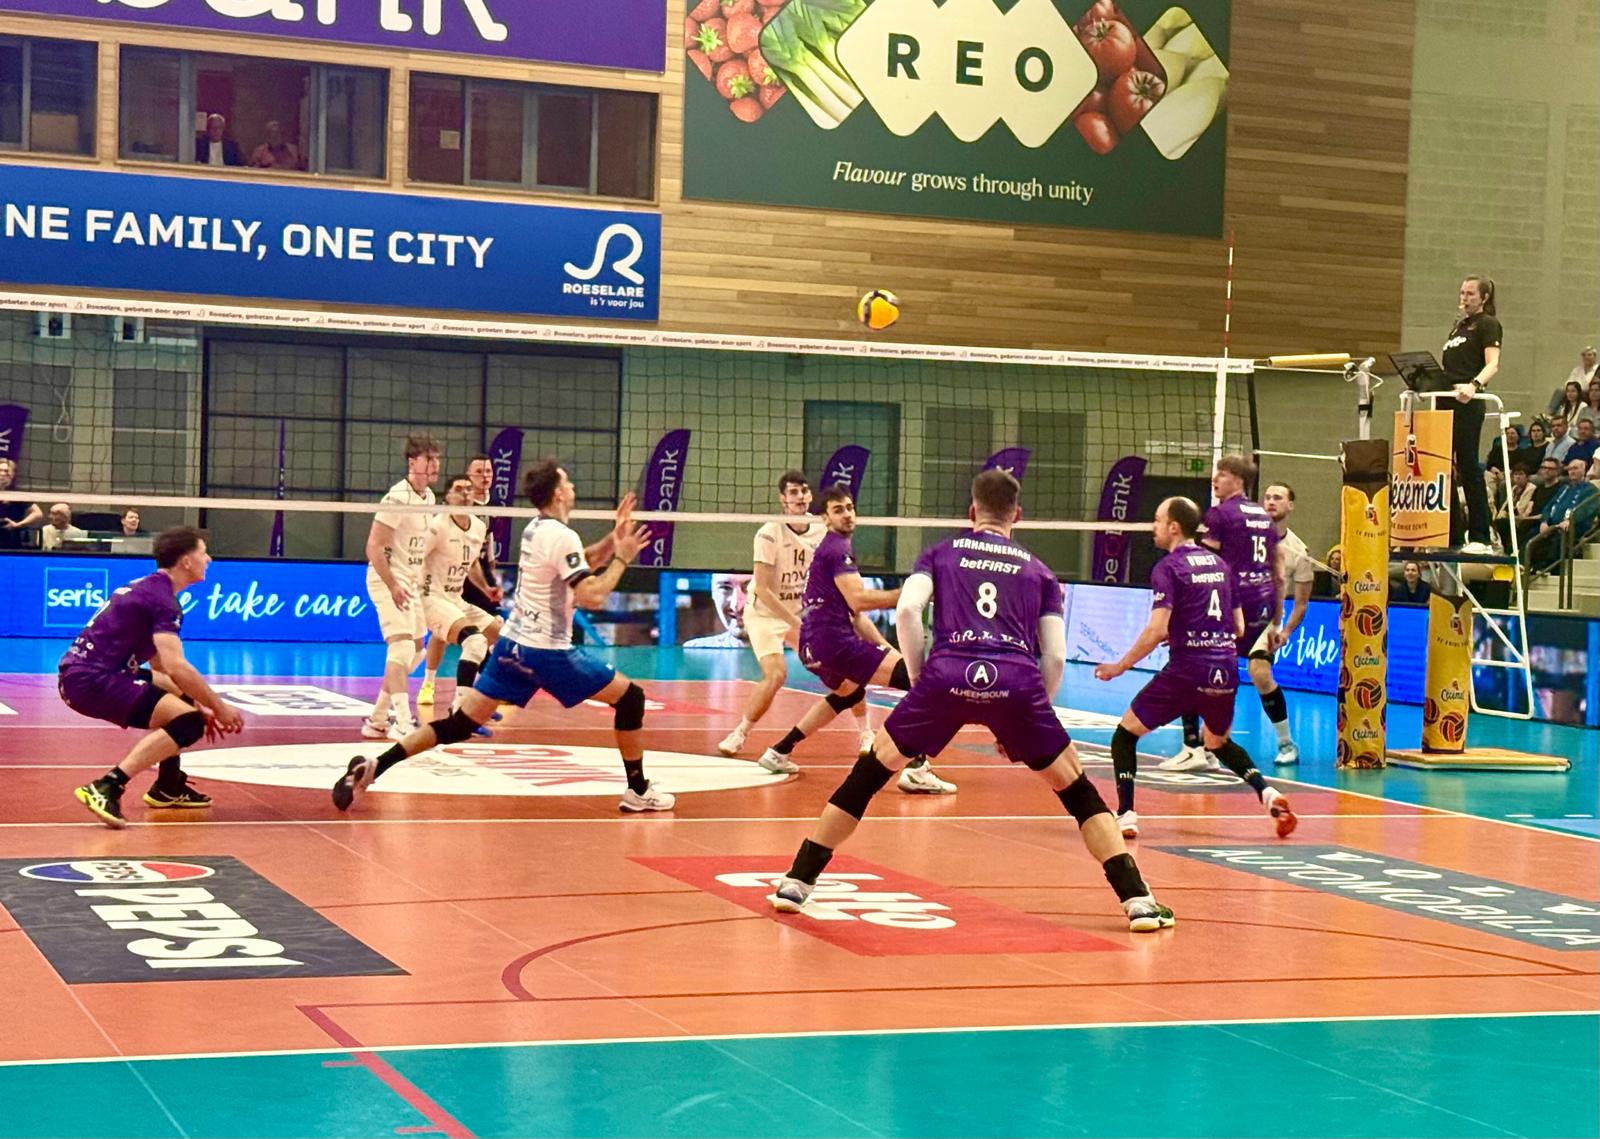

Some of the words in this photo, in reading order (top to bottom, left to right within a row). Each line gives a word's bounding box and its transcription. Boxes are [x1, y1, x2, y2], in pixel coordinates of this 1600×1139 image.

[887, 33, 1054, 92] REO
[832, 161, 907, 187] Flavour
[911, 172, 967, 192] grows
[972, 173, 1043, 199] through
[1048, 181, 1094, 206] unity
[86, 208, 268, 261] FAMILY,
[282, 223, 375, 261] ONE
[387, 231, 494, 268] CITY
[562, 283, 645, 298] ROESELARE
[590, 297, 598, 306] is
[608, 298, 628, 308] voor
[629, 299, 644, 309] jou
[793, 549, 806, 567] 14
[953, 538, 1031, 562] VERHANNEMAN
[1251, 535, 1267, 563] 15
[960, 557, 1021, 575] betFIRST
[48, 582, 105, 607] seris
[207, 580, 286, 622] take
[295, 593, 368, 618] care
[976, 582, 997, 619] 8
[1207, 589, 1222, 622] 4
[1297, 624, 1339, 669] take
[74, 887, 304, 969] PEPSI
